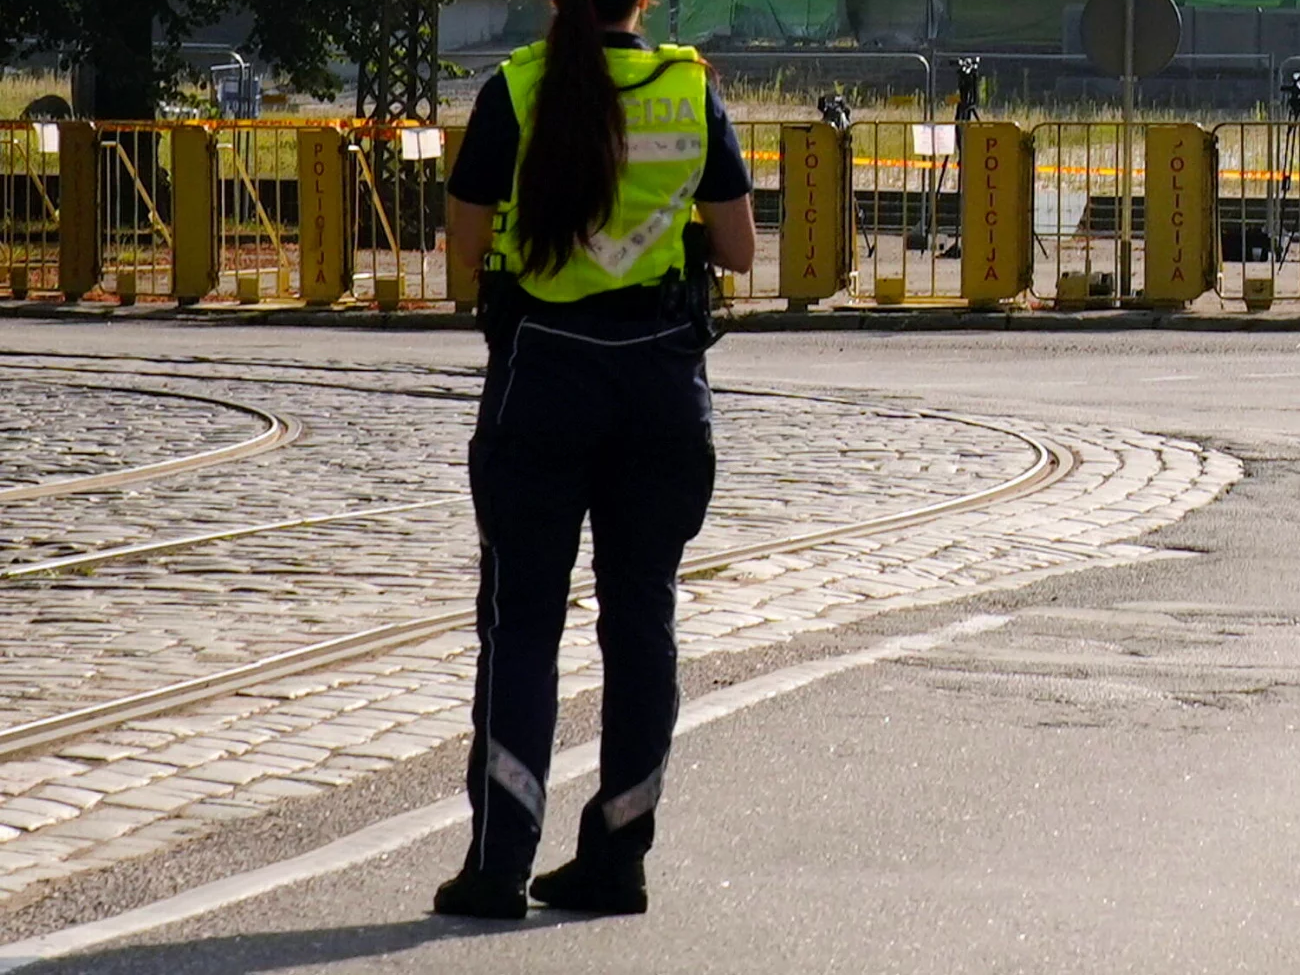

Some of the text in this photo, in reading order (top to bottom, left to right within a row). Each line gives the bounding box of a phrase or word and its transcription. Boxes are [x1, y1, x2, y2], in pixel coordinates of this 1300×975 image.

[625, 97, 699, 125] CIJA
[314, 143, 327, 285] POLICIJA
[803, 131, 817, 280] POLICIJA
[984, 137, 999, 282] POLICIJA
[1170, 137, 1185, 283] OLICIJA
